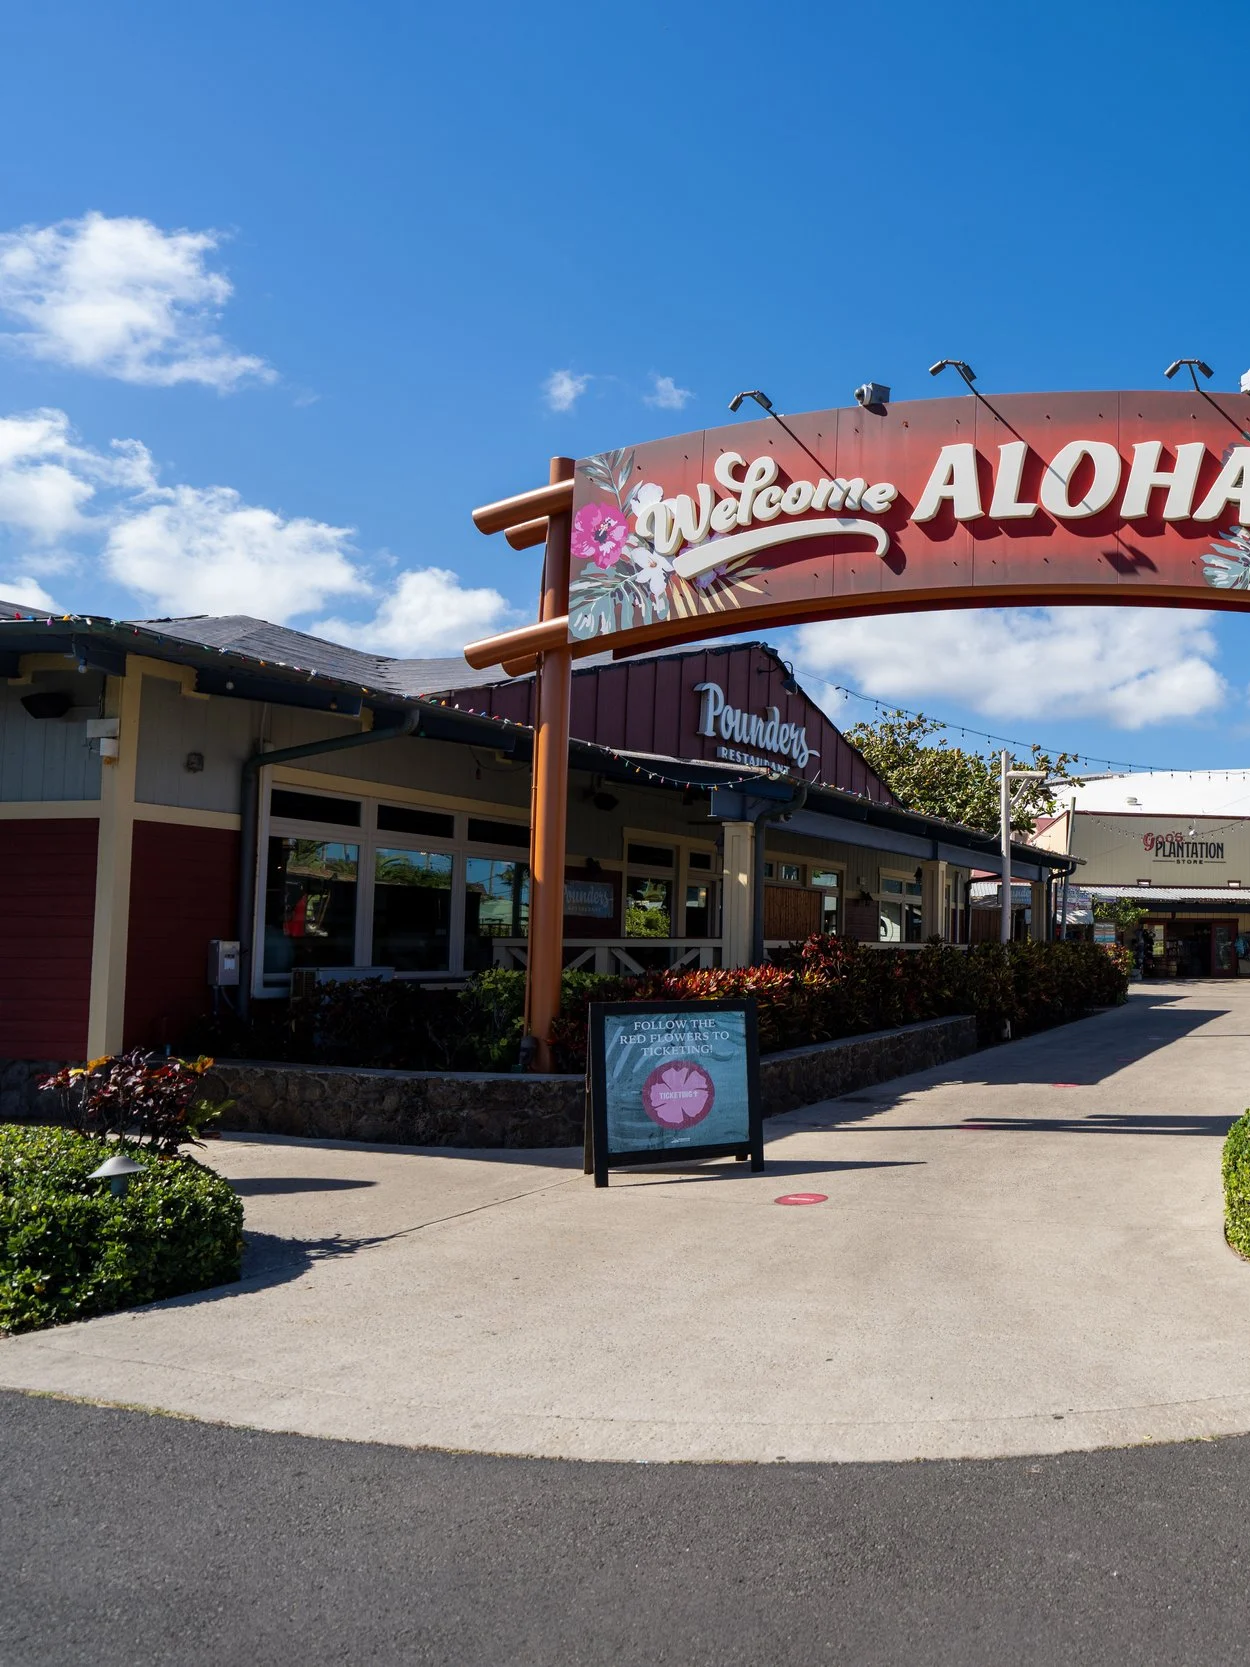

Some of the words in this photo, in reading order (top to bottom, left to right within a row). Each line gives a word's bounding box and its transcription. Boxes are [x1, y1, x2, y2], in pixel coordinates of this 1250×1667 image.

[636, 452, 898, 556] Welcome
[694, 682, 820, 769] Pounders
[1155, 841, 1224, 859] PLANTATION
[565, 884, 614, 908] ounders
[634, 1020, 688, 1031] FOLLOW
[690, 1019, 716, 1029] THE
[620, 1035, 647, 1045] RED
[650, 1032, 709, 1044] FLOWERS
[712, 1031, 730, 1041] TO
[641, 1045, 713, 1057] TICKETING!
[659, 1090, 693, 1100] TICKETING
